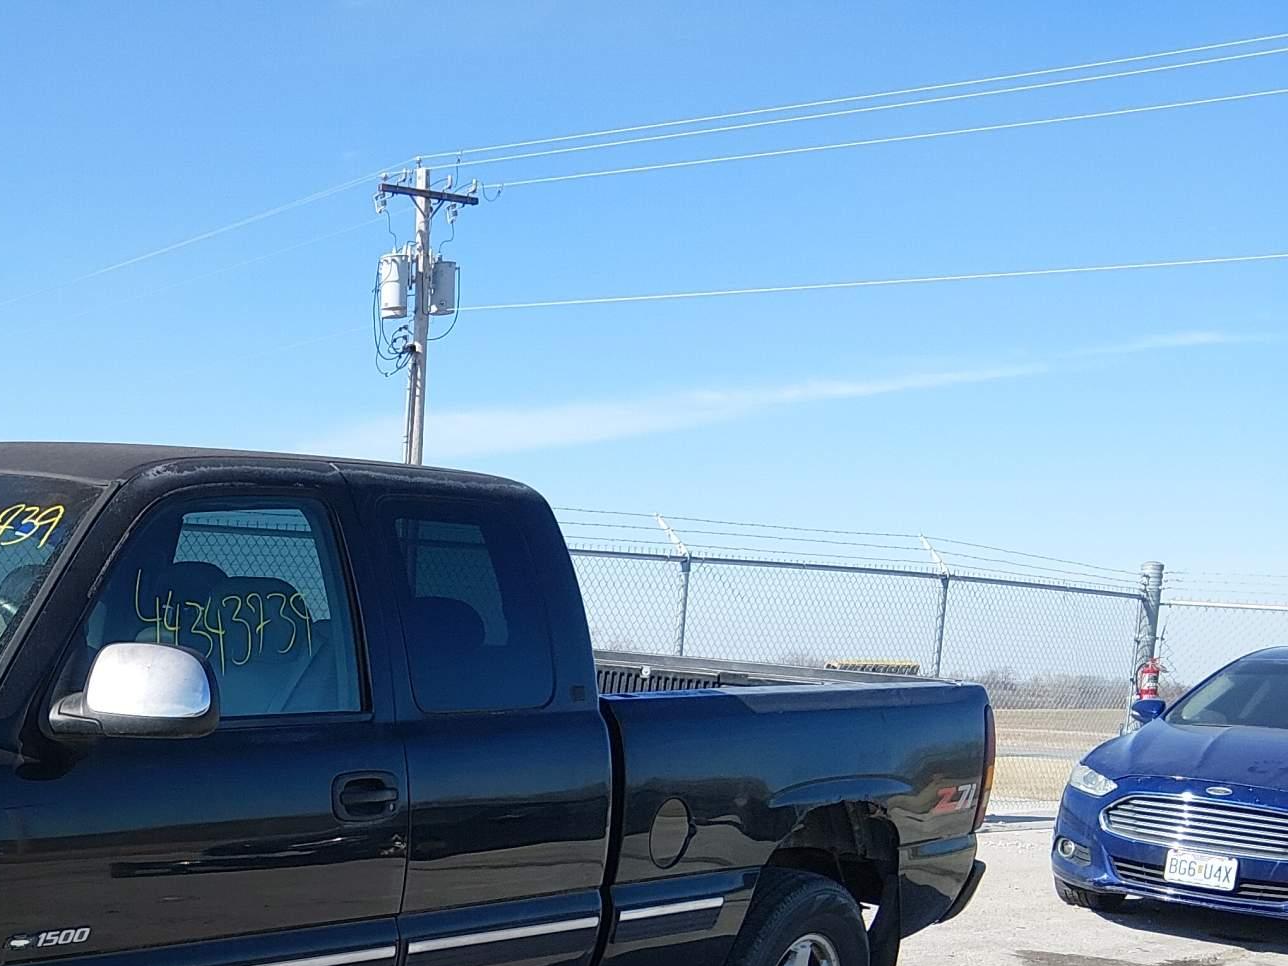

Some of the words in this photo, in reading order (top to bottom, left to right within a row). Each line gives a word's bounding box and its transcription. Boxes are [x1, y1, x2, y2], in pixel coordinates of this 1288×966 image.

[135, 568, 313, 676] 44343739
[935, 784, 977, 814] Z71
[1169, 858, 1197, 877] BG6
[1204, 864, 1232, 883] U4X
[36, 927, 91, 947] 1500
